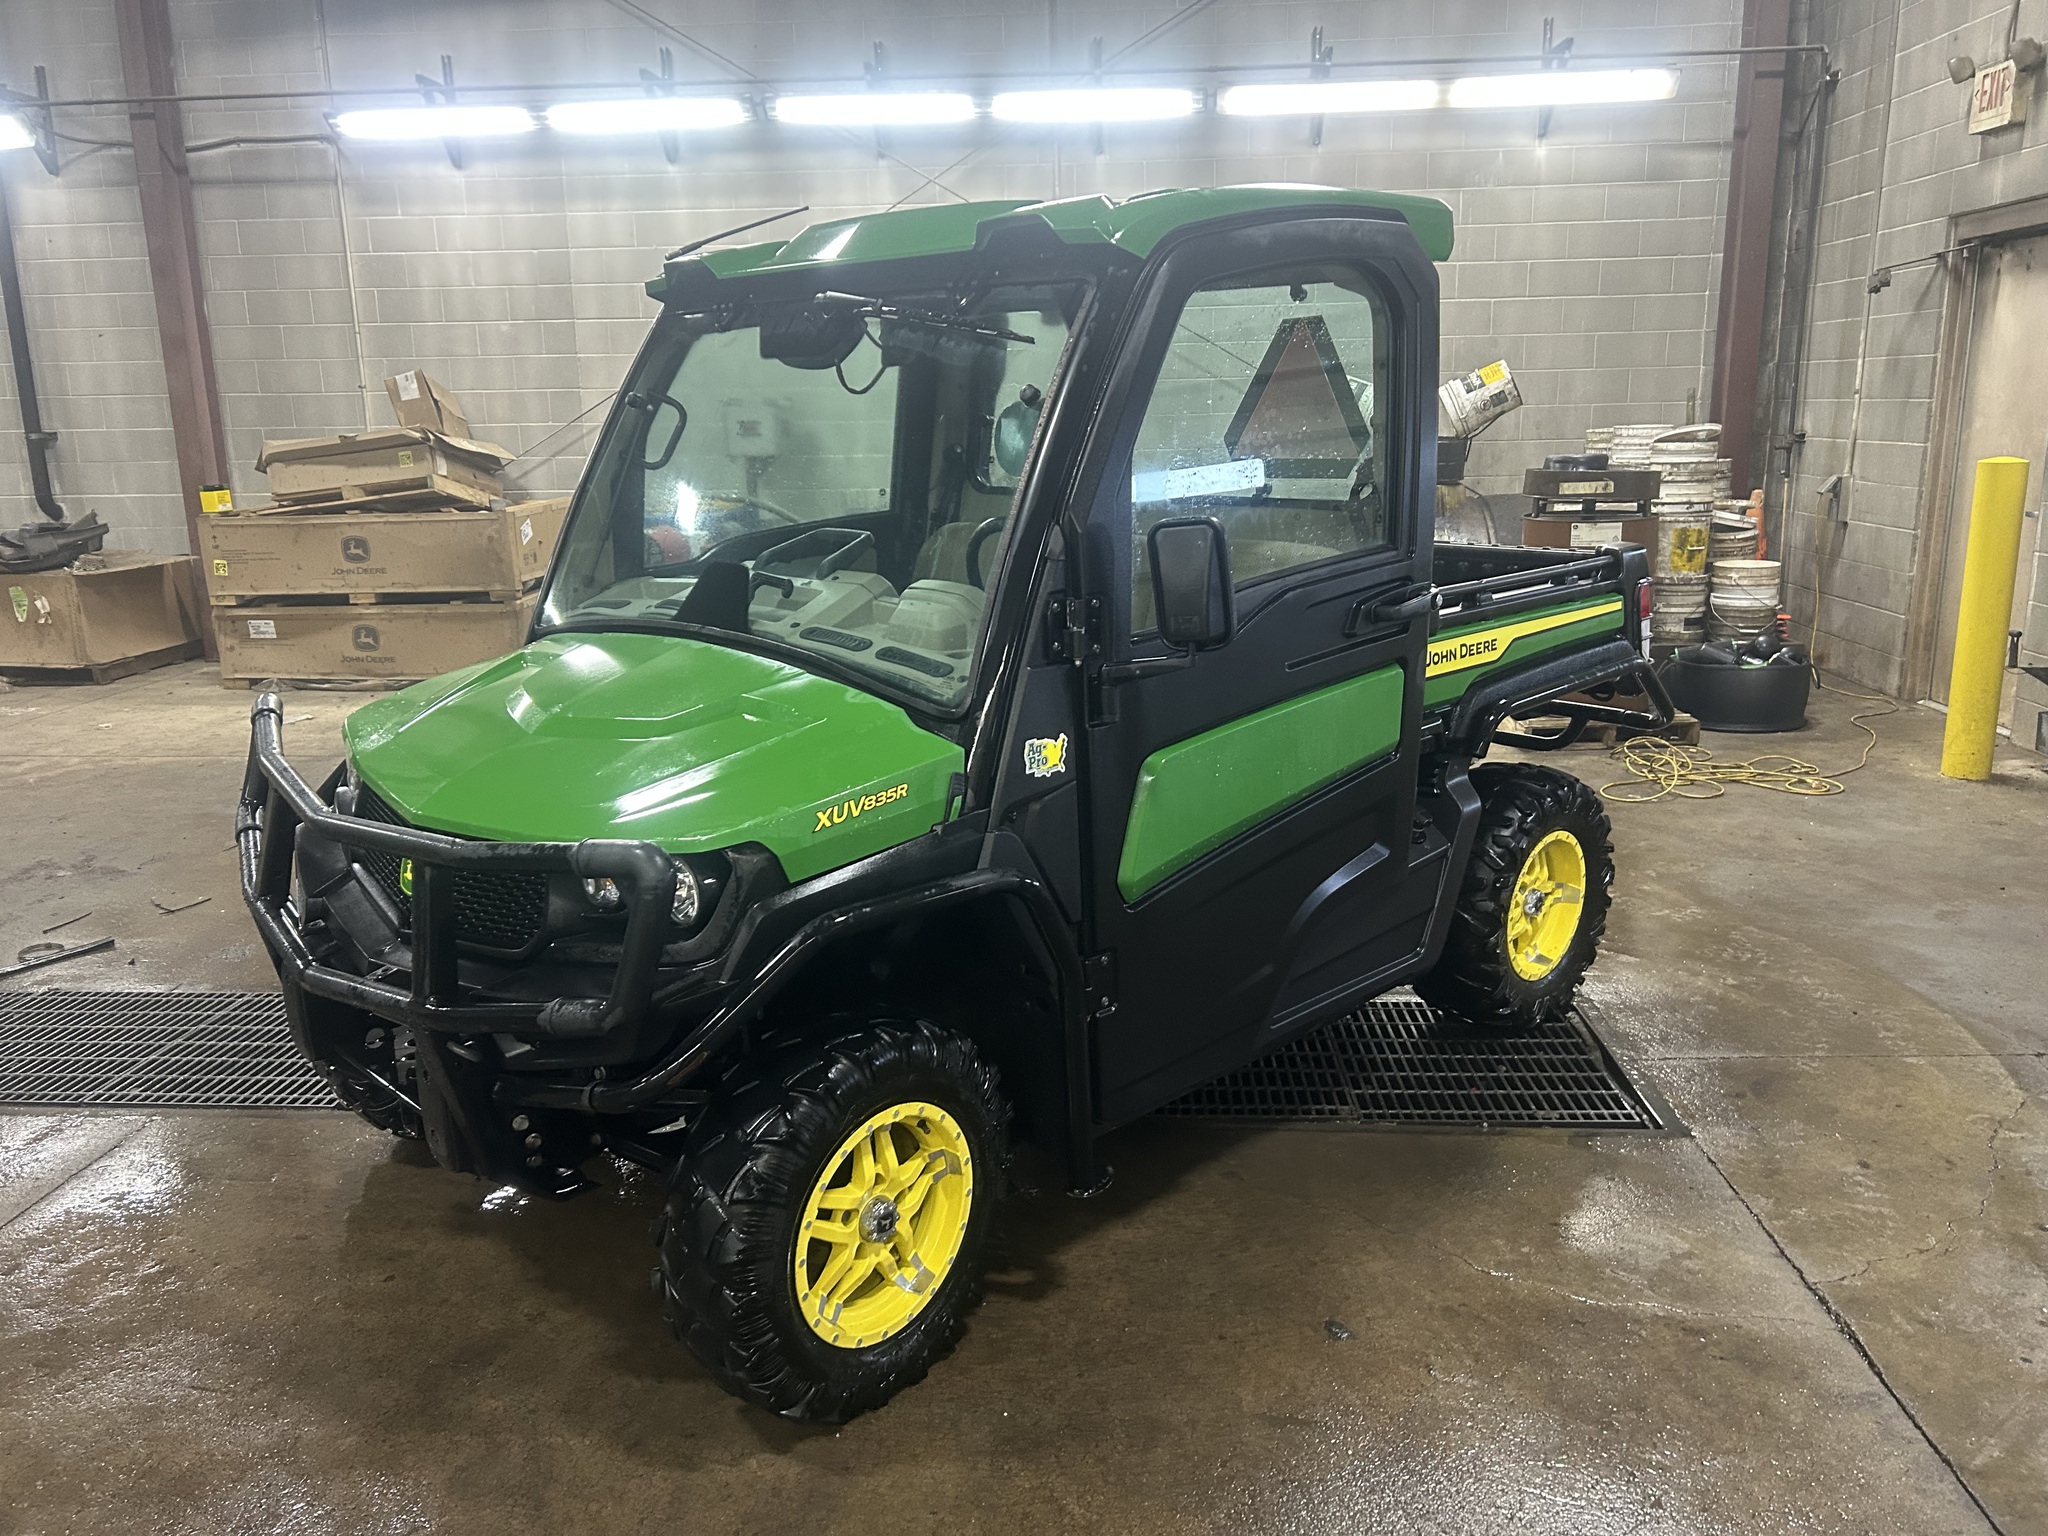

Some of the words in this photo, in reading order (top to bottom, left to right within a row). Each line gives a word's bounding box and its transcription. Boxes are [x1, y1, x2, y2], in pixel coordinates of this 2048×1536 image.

[1978, 66, 2010, 114] EXIT
[331, 566, 356, 576] JOHN
[356, 566, 388, 575] DEERE
[340, 654, 365, 664] JOHN
[365, 655, 397, 664] DEERE
[1426, 648, 1457, 668] JOHN
[1459, 638, 1498, 659] DEERE
[1028, 756, 1048, 770] Pro
[812, 782, 909, 834] XUV835R
